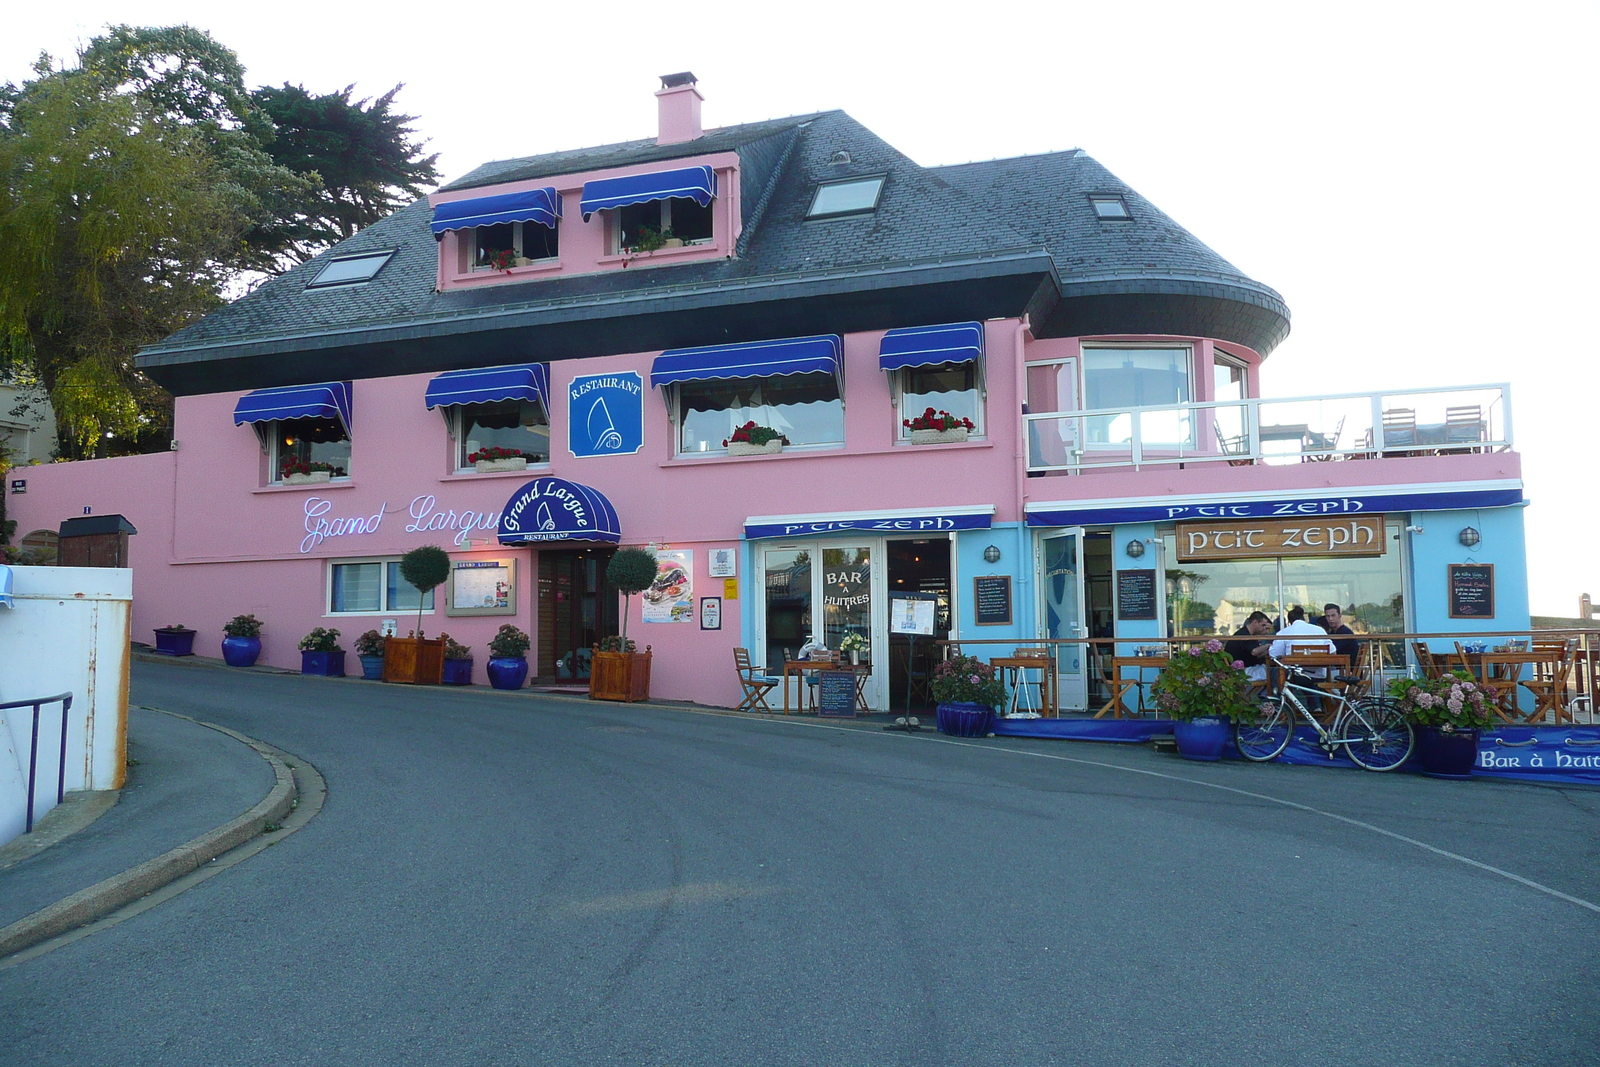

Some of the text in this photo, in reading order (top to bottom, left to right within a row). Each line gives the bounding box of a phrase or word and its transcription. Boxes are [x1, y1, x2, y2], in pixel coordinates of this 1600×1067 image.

[571, 378, 641, 400] RESTAURANT
[504, 480, 588, 531] Grand Largue
[300, 497, 387, 553] Grand
[523, 533, 570, 541] RESTAURANT
[826, 571, 862, 585] BAR
[824, 594, 870, 606] HUITRES
[1481, 751, 1520, 768] Bar
[1530, 753, 1543, 768] à
